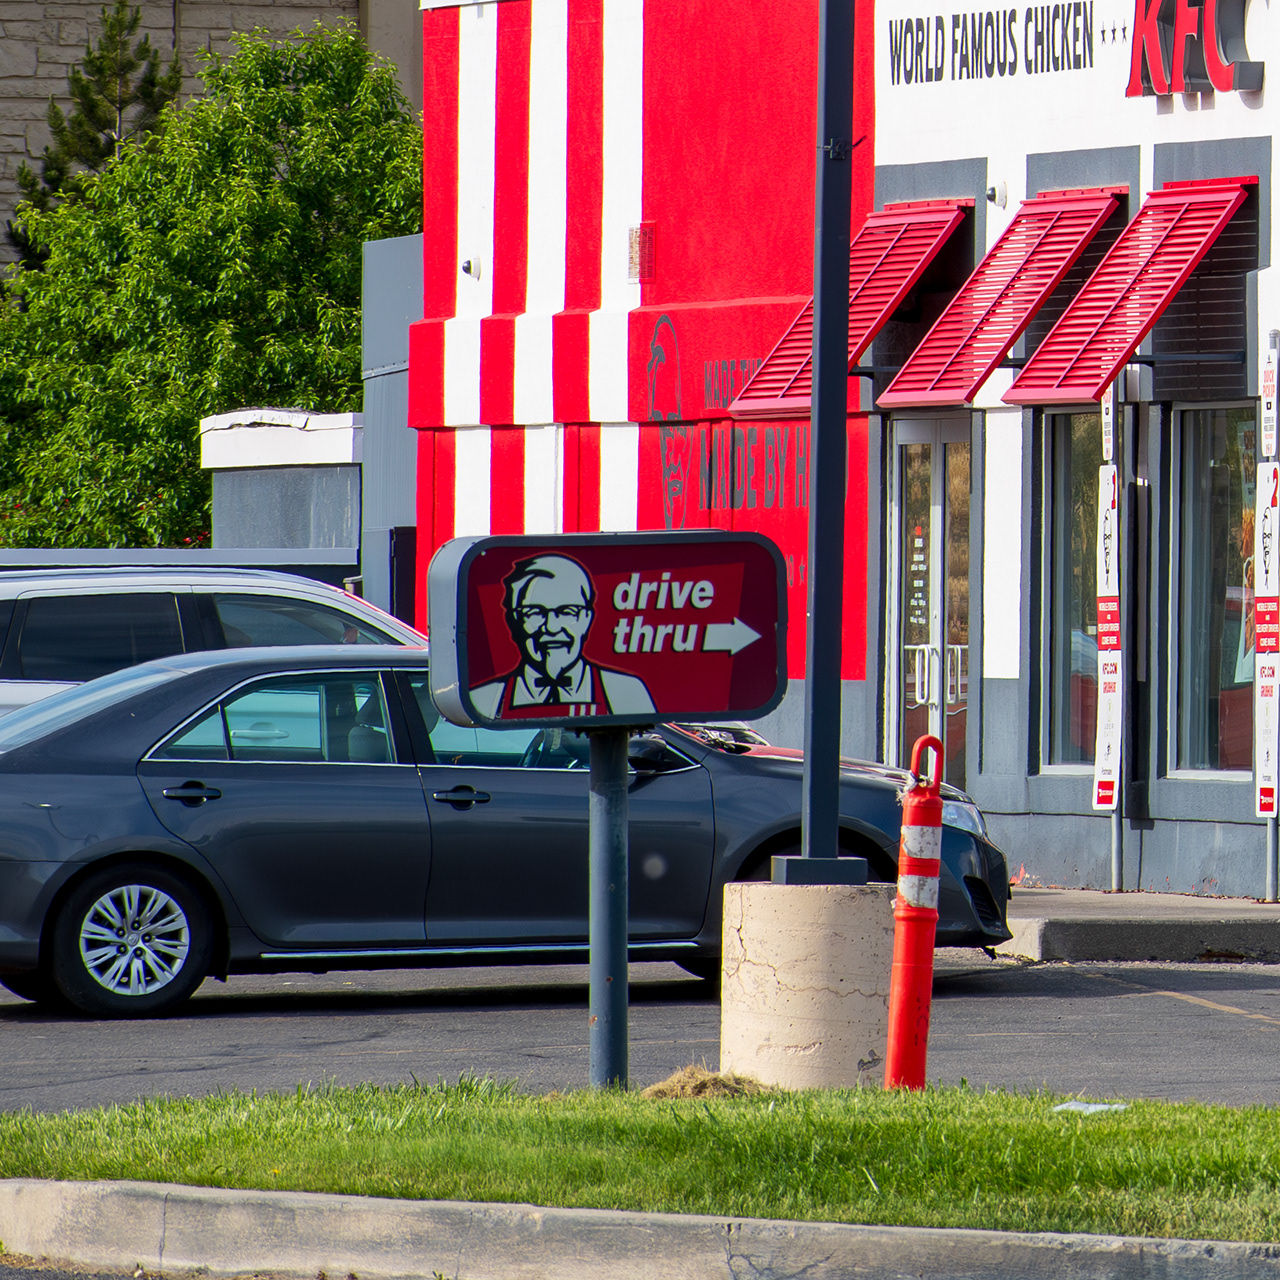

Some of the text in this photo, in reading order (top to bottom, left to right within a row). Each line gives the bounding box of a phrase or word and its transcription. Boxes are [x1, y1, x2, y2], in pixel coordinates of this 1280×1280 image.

[889, 0, 1094, 86] WORLD FAMOUS CHICKEN
[704, 360, 736, 410] MADE
[700, 427, 758, 510] MADE
[764, 426, 789, 509] BY
[1270, 467, 1279, 507] 2
[611, 572, 715, 611] drive
[612, 615, 699, 654] thru
